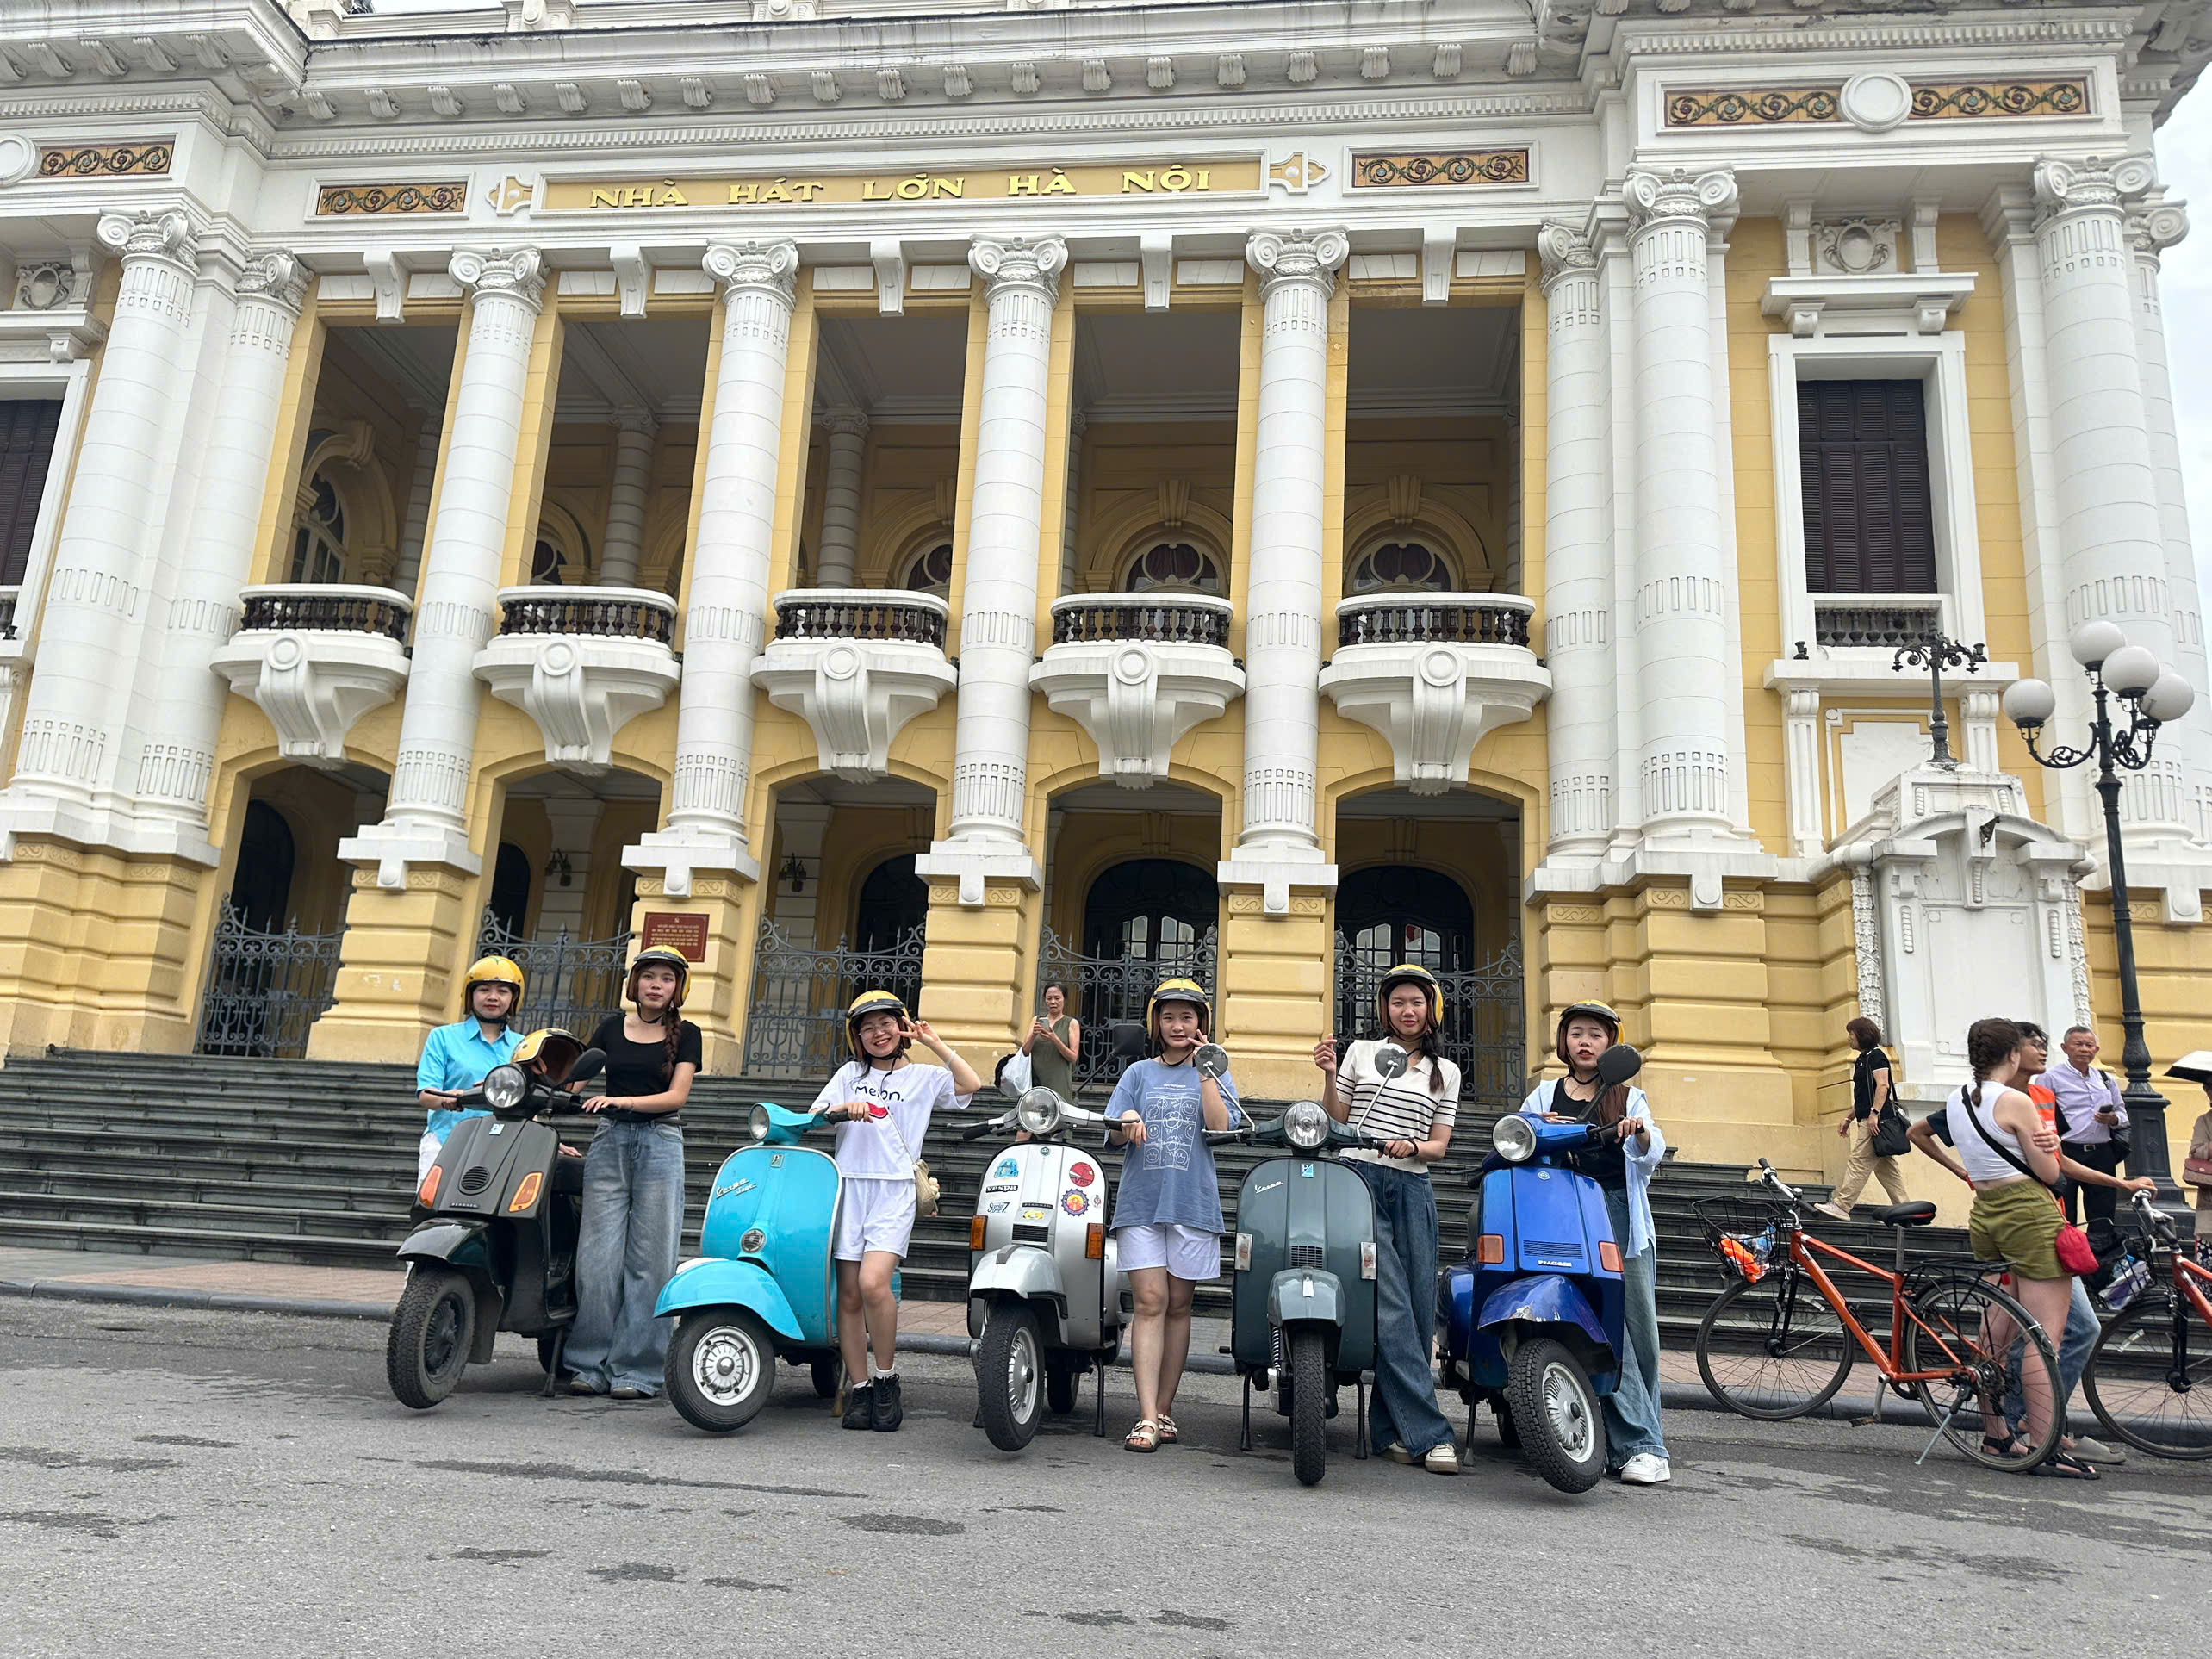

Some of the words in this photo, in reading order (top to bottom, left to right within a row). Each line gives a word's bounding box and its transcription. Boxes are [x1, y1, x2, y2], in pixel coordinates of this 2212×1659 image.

[590, 178, 688, 208] NHÀ
[728, 176, 823, 203] HÁT
[861, 172, 965, 201] LỚN
[1007, 167, 1077, 196] HÀ
[1122, 164, 1210, 193] NỘI
